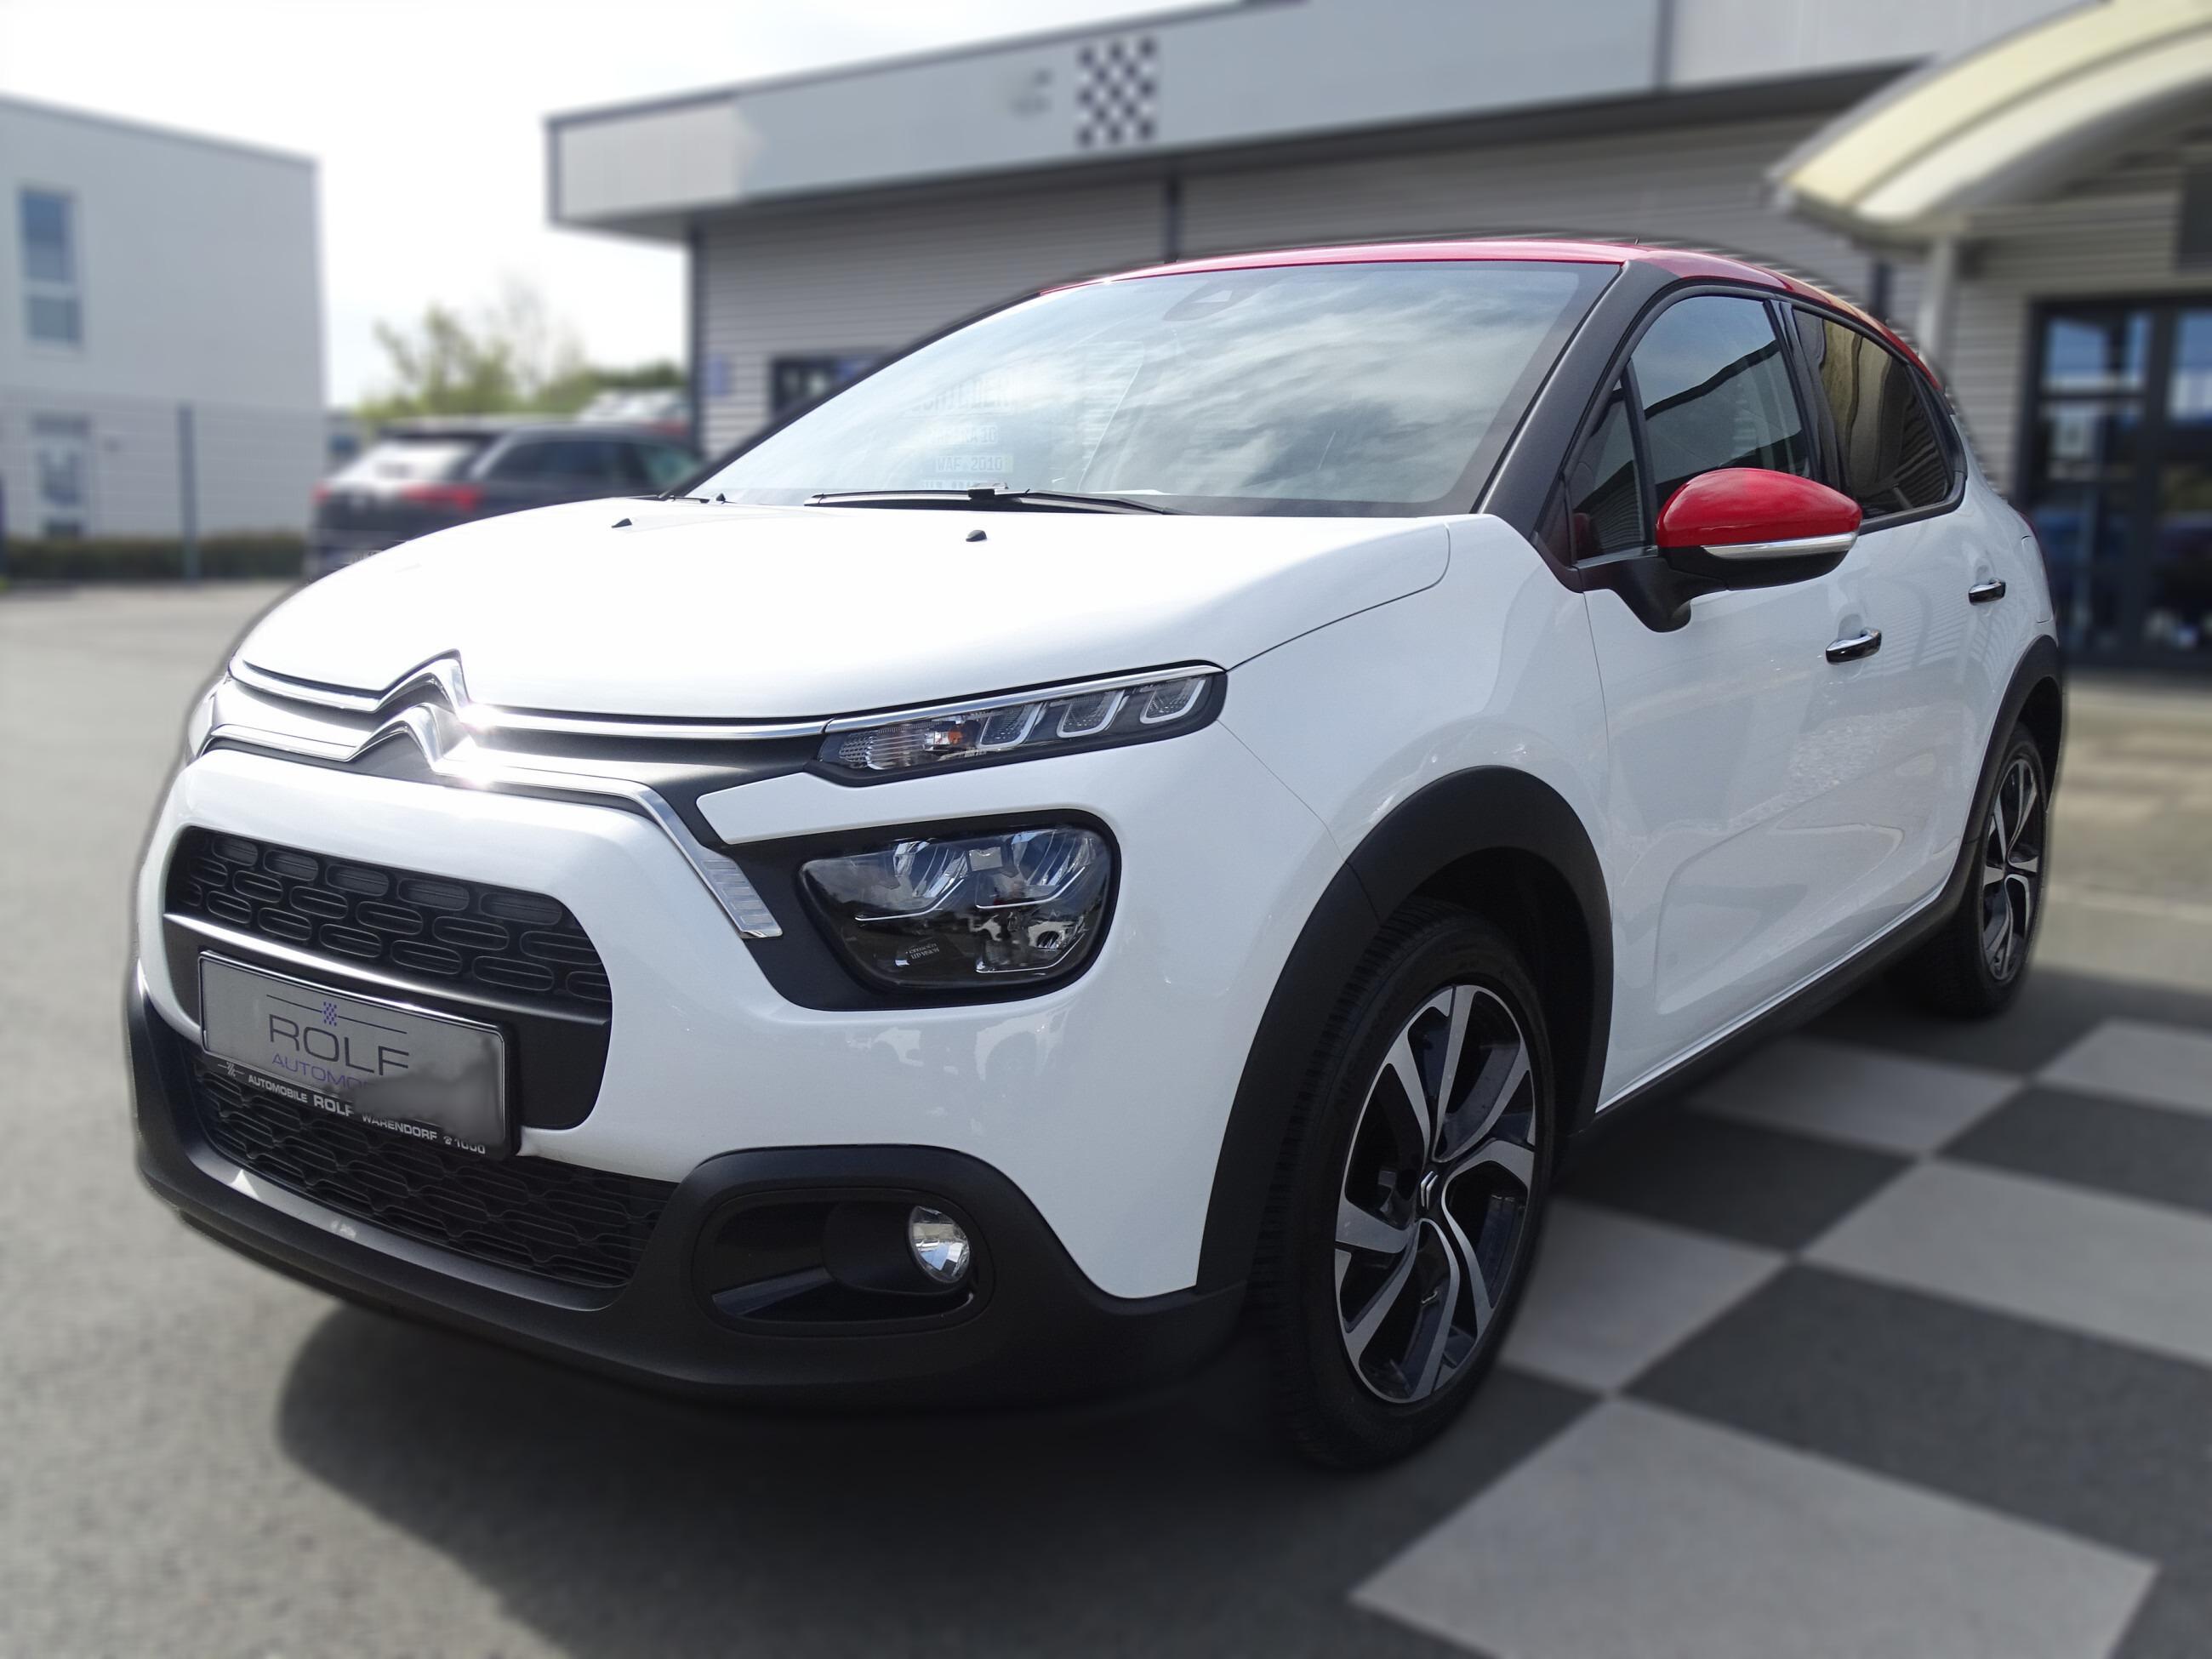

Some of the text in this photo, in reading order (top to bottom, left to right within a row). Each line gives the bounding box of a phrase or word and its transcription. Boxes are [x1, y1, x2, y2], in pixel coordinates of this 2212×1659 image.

[938, 457, 1003, 471] WAF 2010
[269, 1013, 409, 1076] ROLF
[248, 1074, 308, 1104] AUTOMOBILE
[313, 1093, 355, 1117] ROLF
[362, 1114, 438, 1141] WARENDORF
